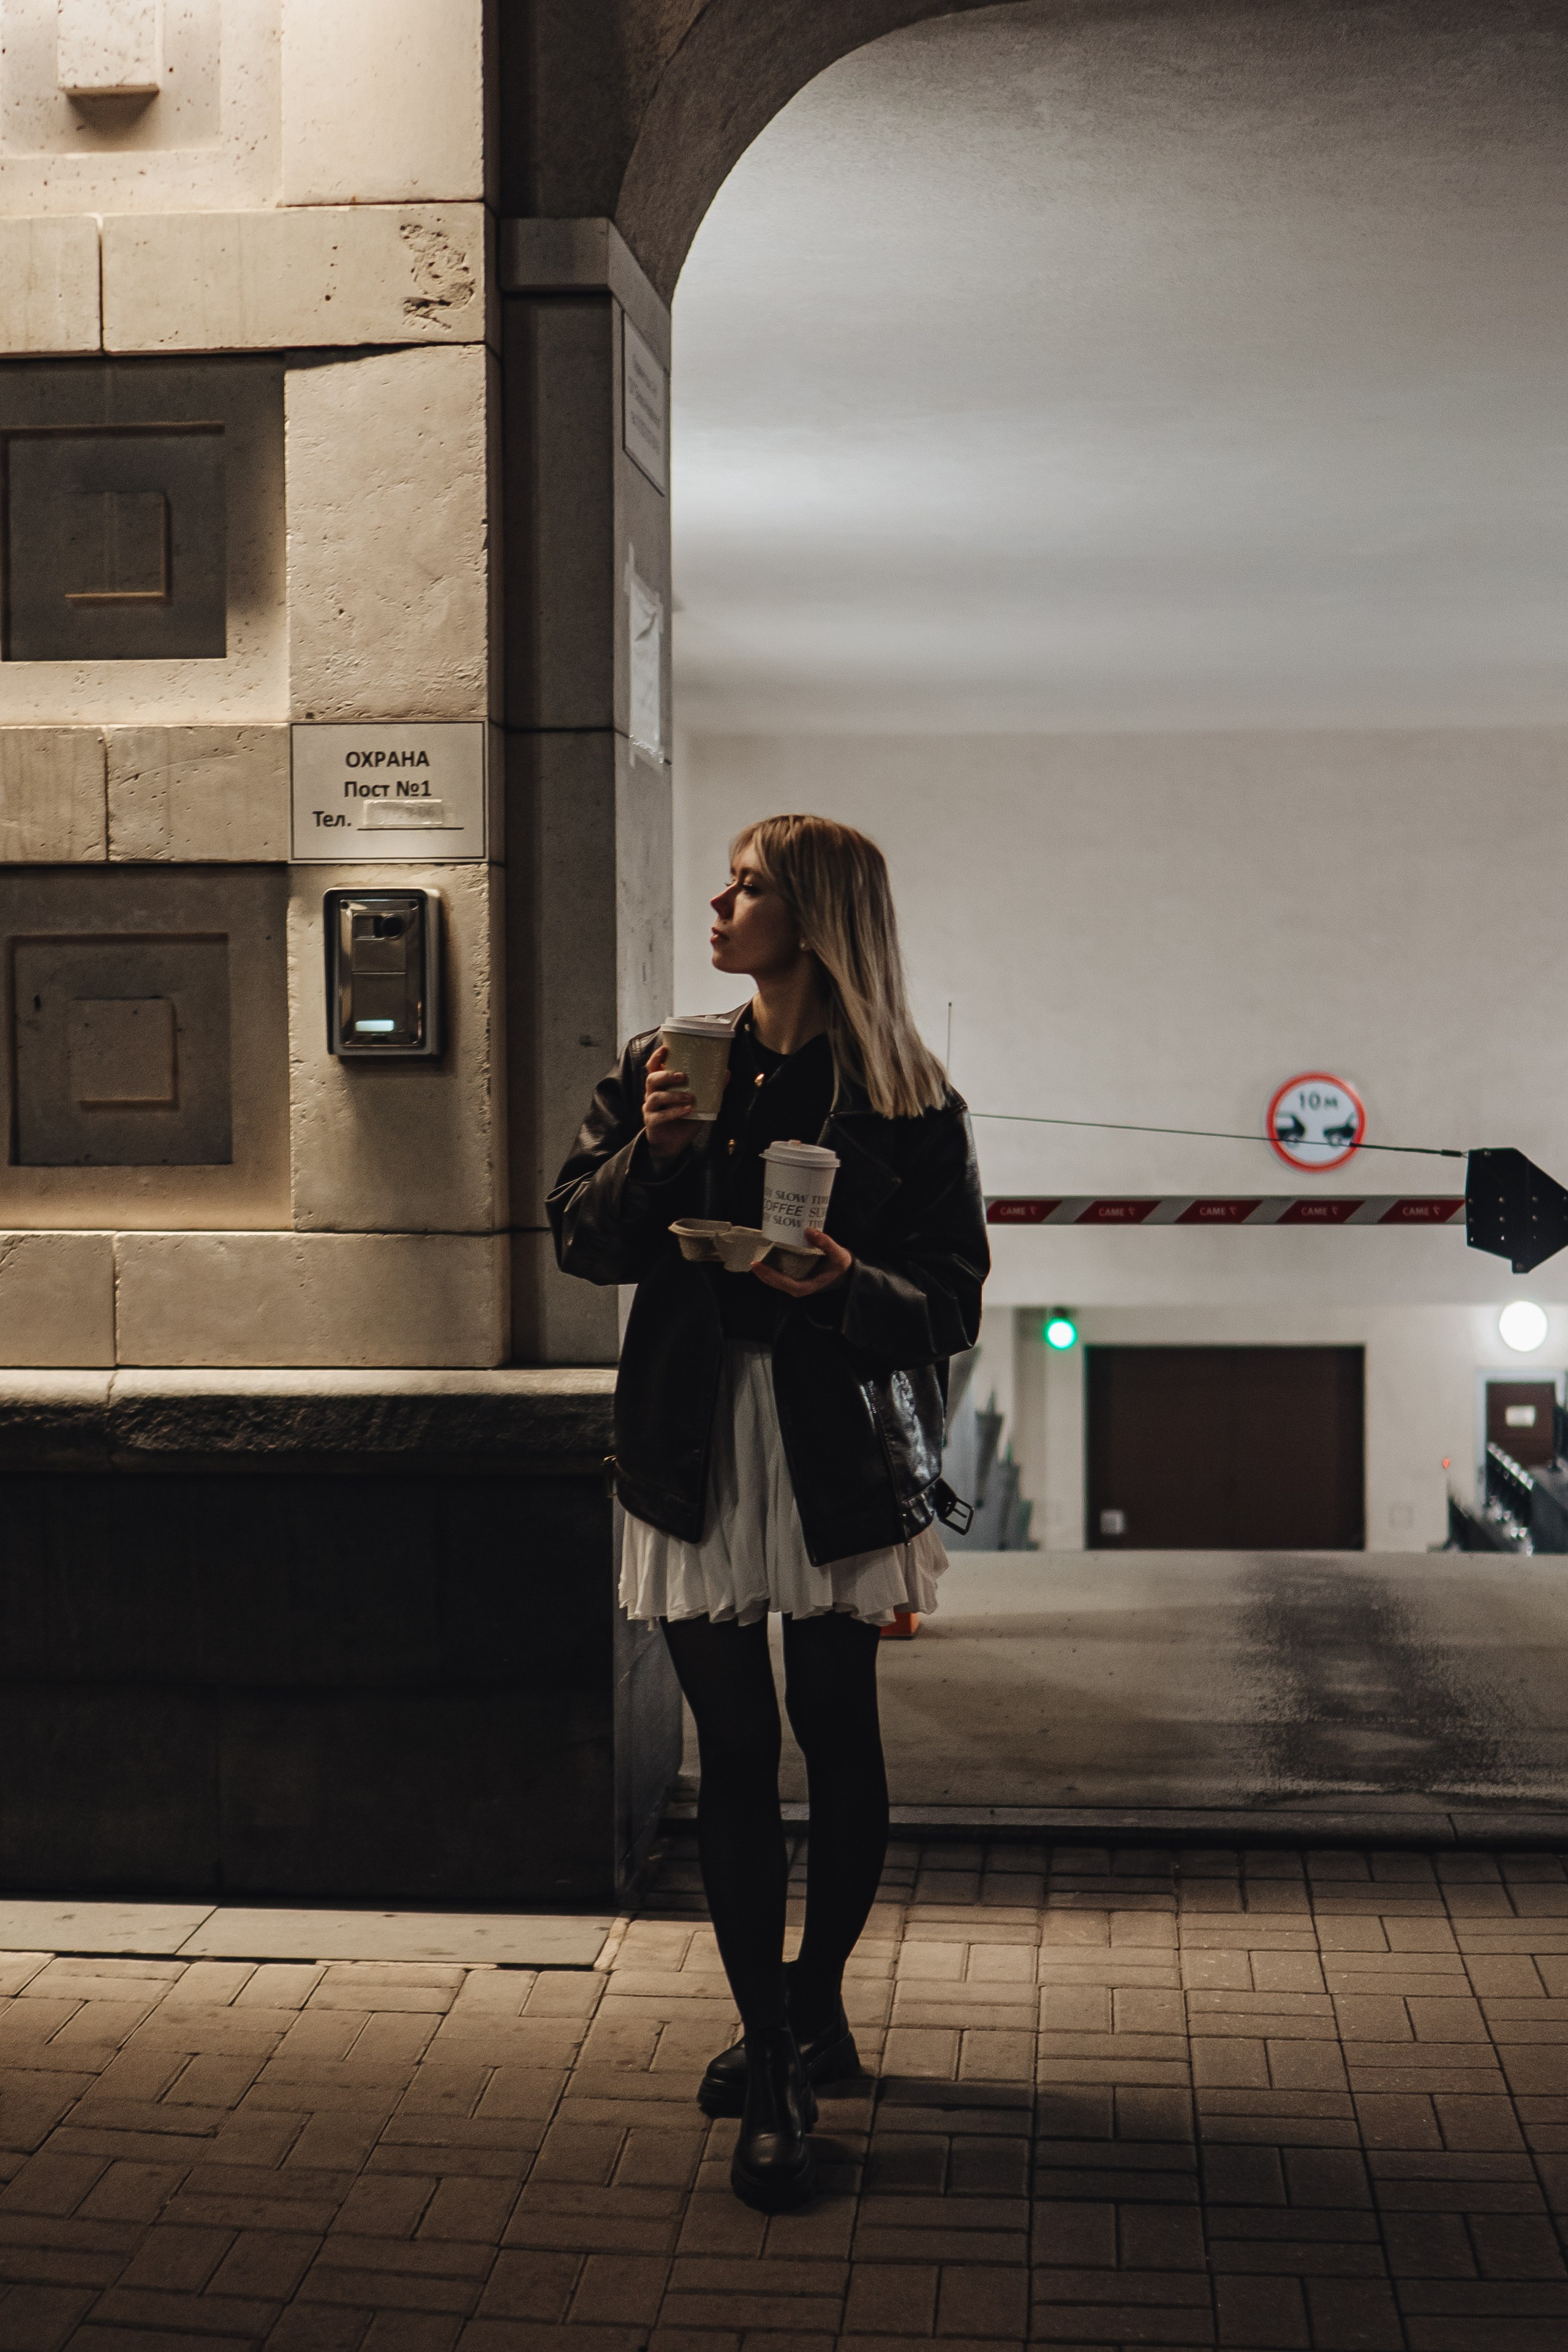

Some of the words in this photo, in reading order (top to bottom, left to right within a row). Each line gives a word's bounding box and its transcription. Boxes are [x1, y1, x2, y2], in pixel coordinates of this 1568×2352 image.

[345, 751, 430, 767] ОХРАНА
[344, 781, 390, 797] Пост
[396, 780, 432, 797] №1
[312, 811, 352, 827] Тел.
[774, 1189, 807, 1204] SLOW
[1000, 1207, 1027, 1216] CAME
[1098, 1207, 1125, 1217] CAME
[1199, 1207, 1226, 1216] CAME
[1300, 1207, 1328, 1216] CAME
[1402, 1207, 1430, 1216] CAME
[773, 1215, 803, 1228] SLOW
